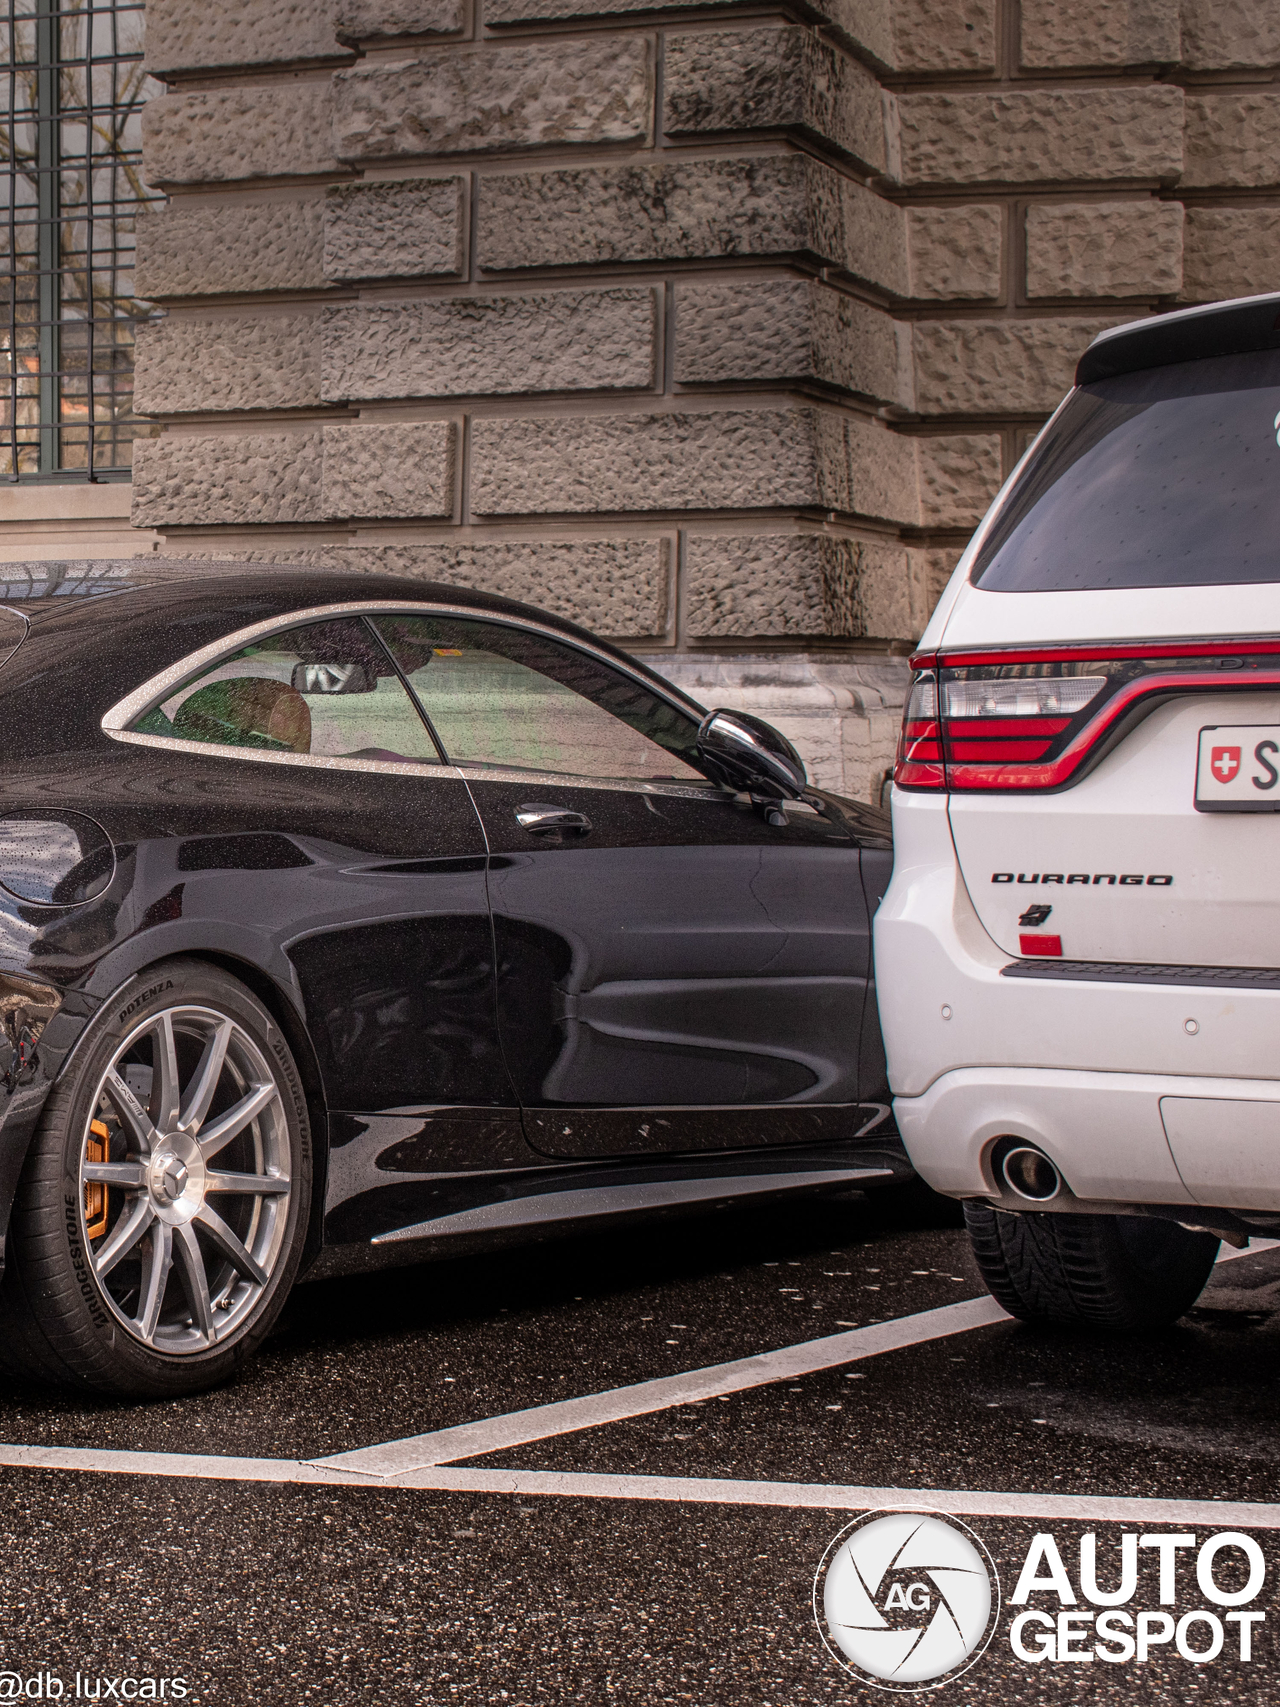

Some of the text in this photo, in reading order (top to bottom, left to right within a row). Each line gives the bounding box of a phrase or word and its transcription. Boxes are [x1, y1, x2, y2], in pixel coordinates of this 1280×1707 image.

[991, 872, 1173, 886] DURANGO
[118, 979, 174, 1023] POTENZA
[64, 1193, 109, 1329] BRIDGESTONE
